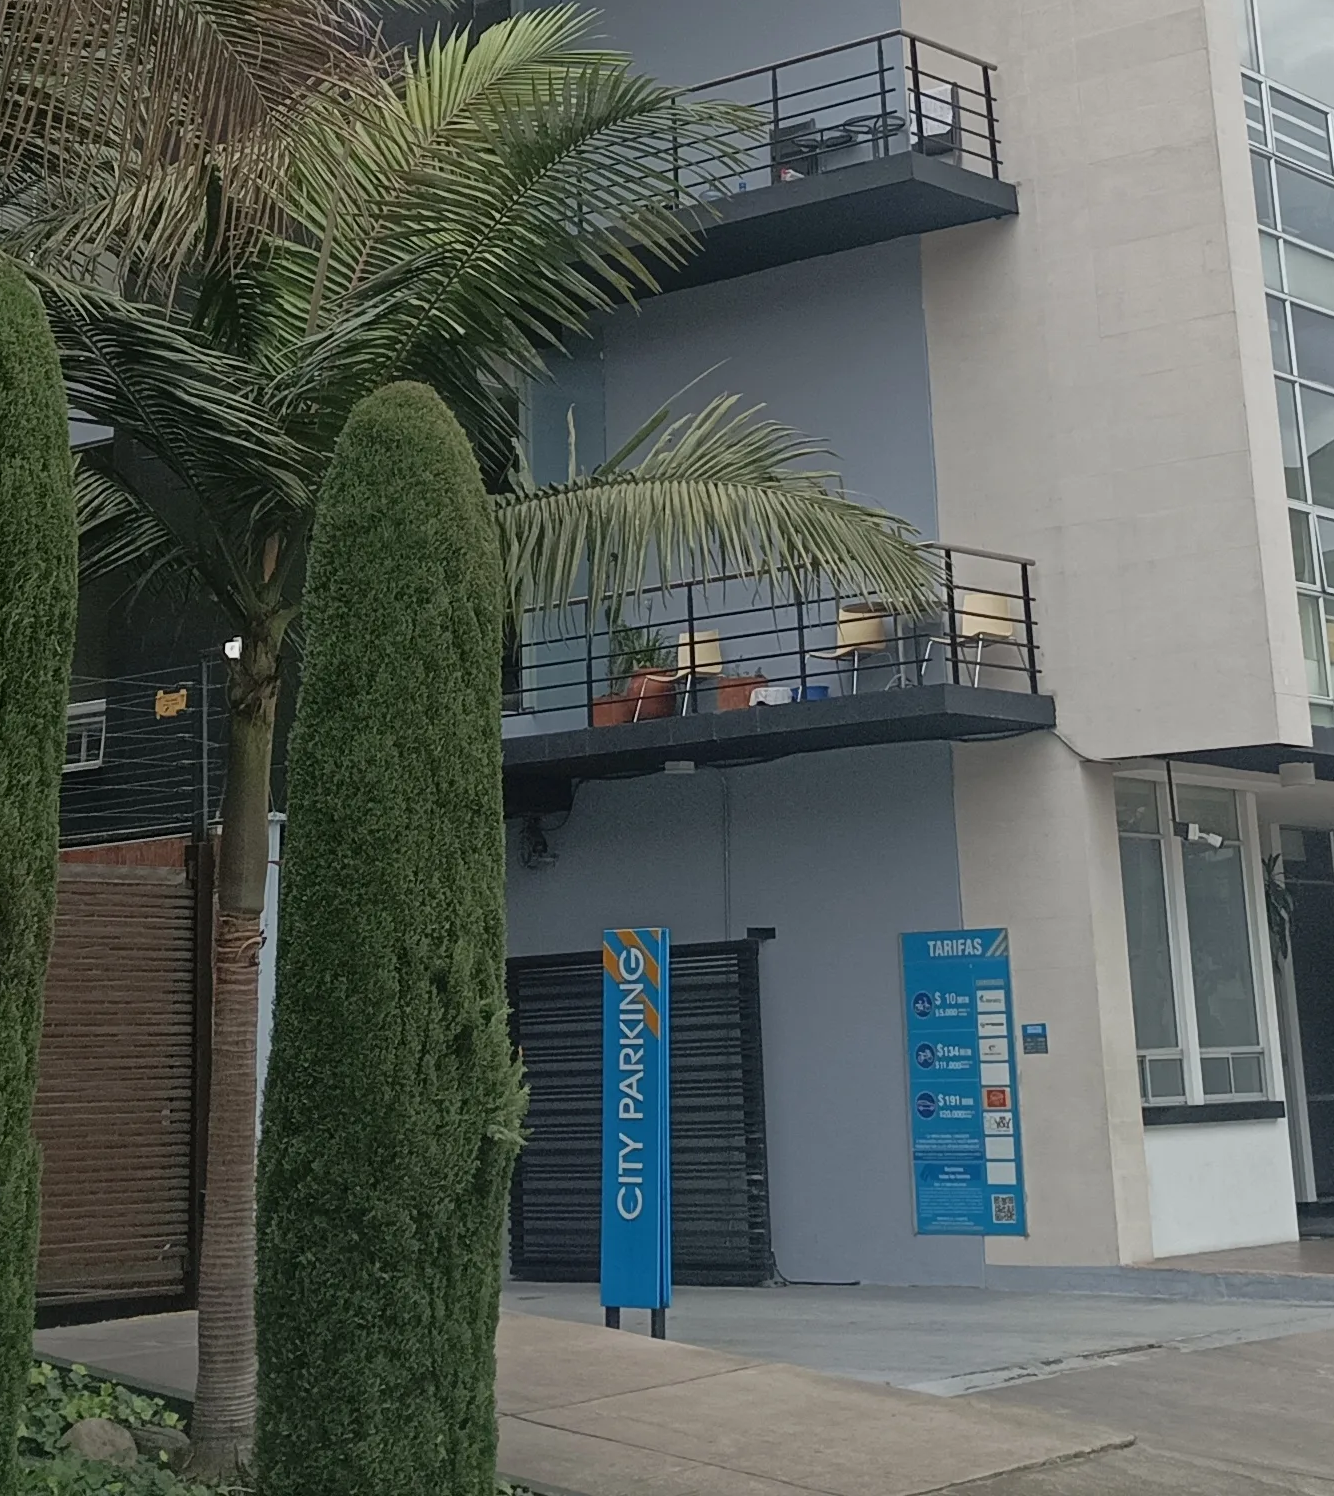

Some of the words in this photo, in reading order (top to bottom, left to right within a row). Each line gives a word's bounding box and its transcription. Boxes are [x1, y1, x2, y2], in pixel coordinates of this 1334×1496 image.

[927, 938, 983, 957] TARIFAS
[618, 946, 645, 1120] PARKING
[617, 1132, 643, 1221] CITY
